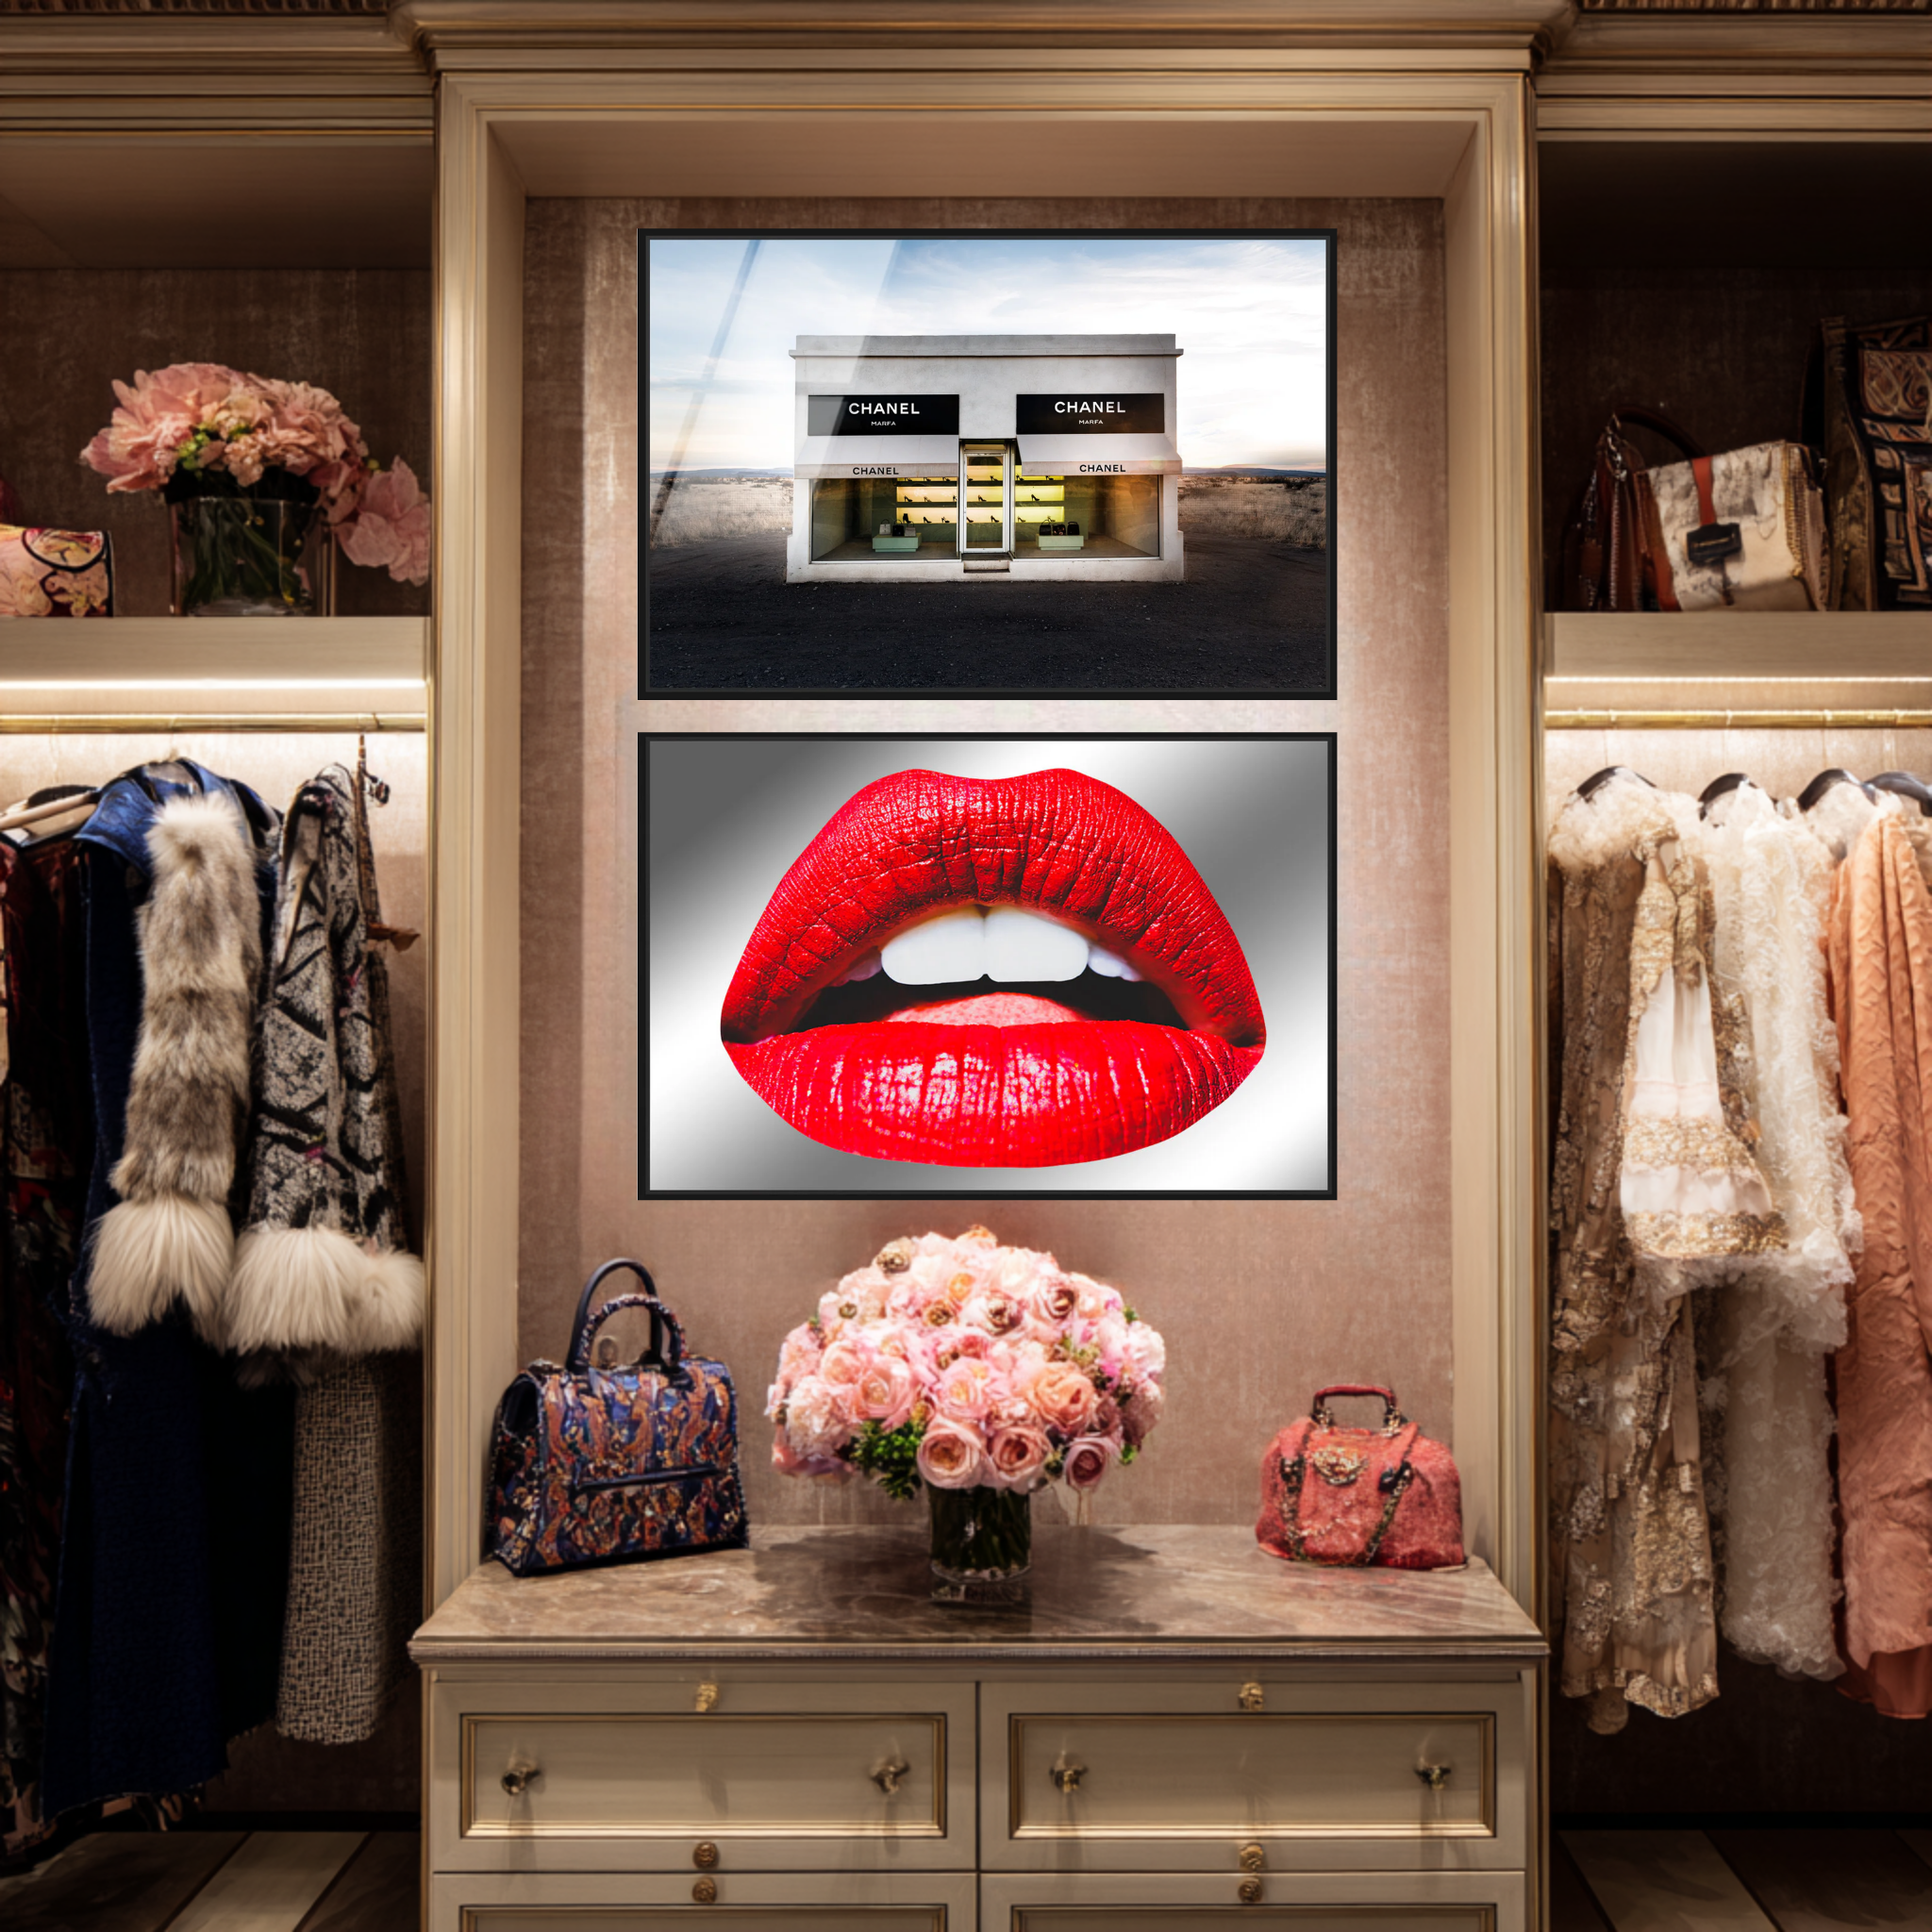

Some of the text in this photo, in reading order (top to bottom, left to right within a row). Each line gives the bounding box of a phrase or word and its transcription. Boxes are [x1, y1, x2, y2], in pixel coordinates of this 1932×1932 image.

[848, 402, 920, 415] CHANEL
[1054, 401, 1126, 414] CHANEL
[852, 467, 899, 475] CHANEL
[1079, 464, 1126, 473] CHANEL
